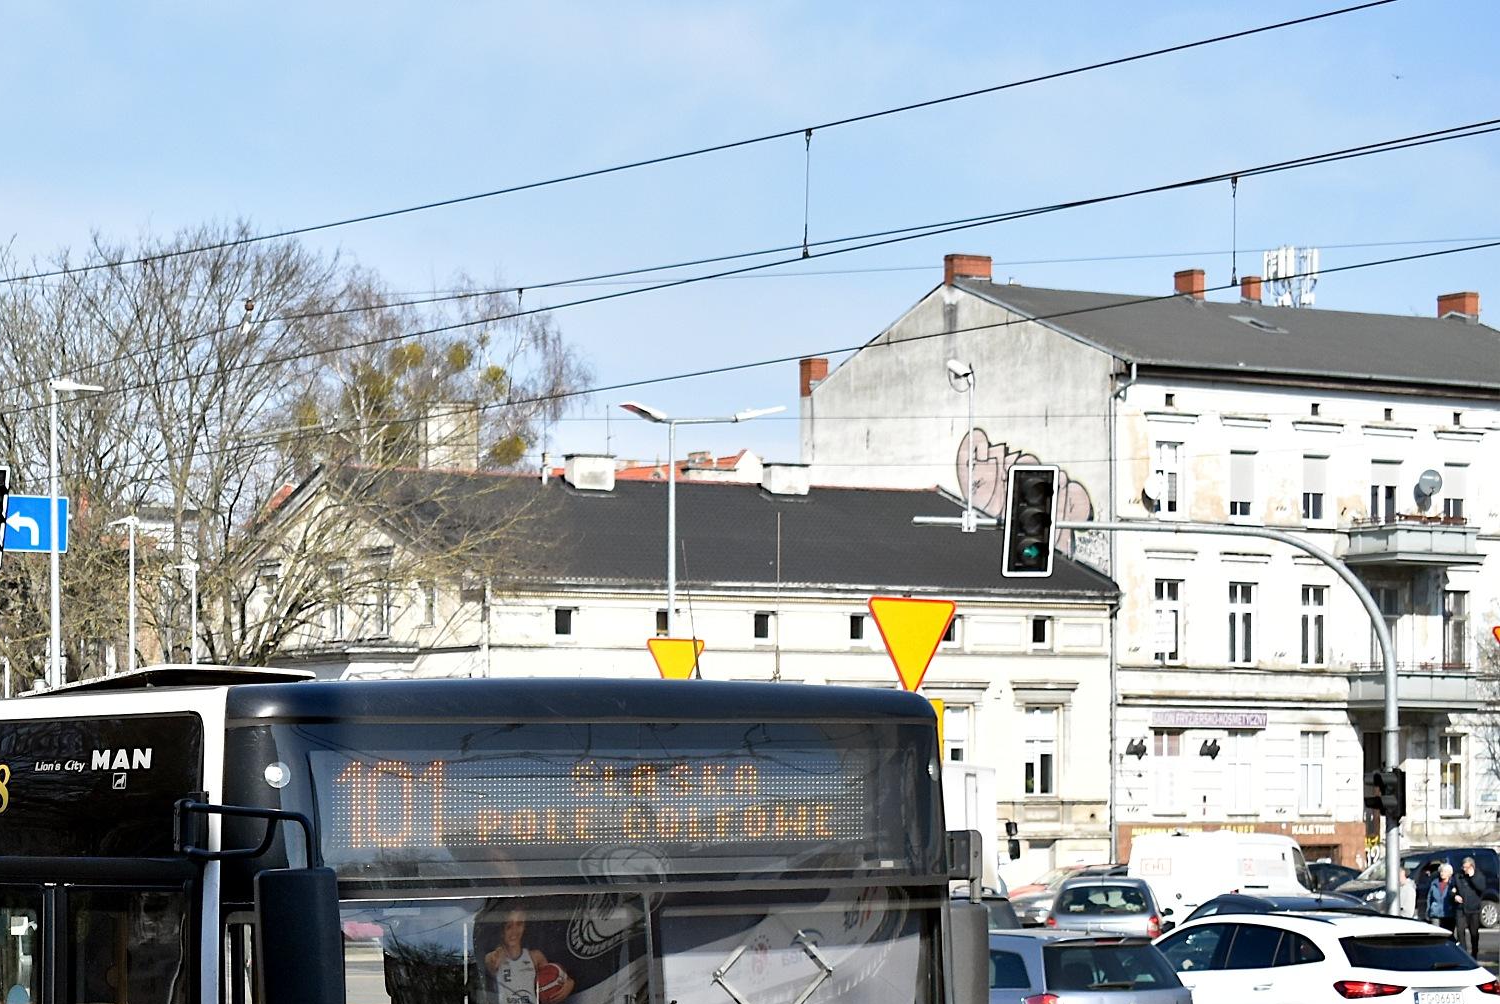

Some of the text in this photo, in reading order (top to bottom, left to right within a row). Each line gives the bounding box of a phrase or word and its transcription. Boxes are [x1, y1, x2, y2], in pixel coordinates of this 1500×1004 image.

[35, 748, 152, 773] Lion's City MAN
[336, 760, 758, 849] 101 ŚLĄSKA
[476, 804, 836, 842] POLE GOLFOWE
[1291, 825, 1336, 835] KALETNIK
